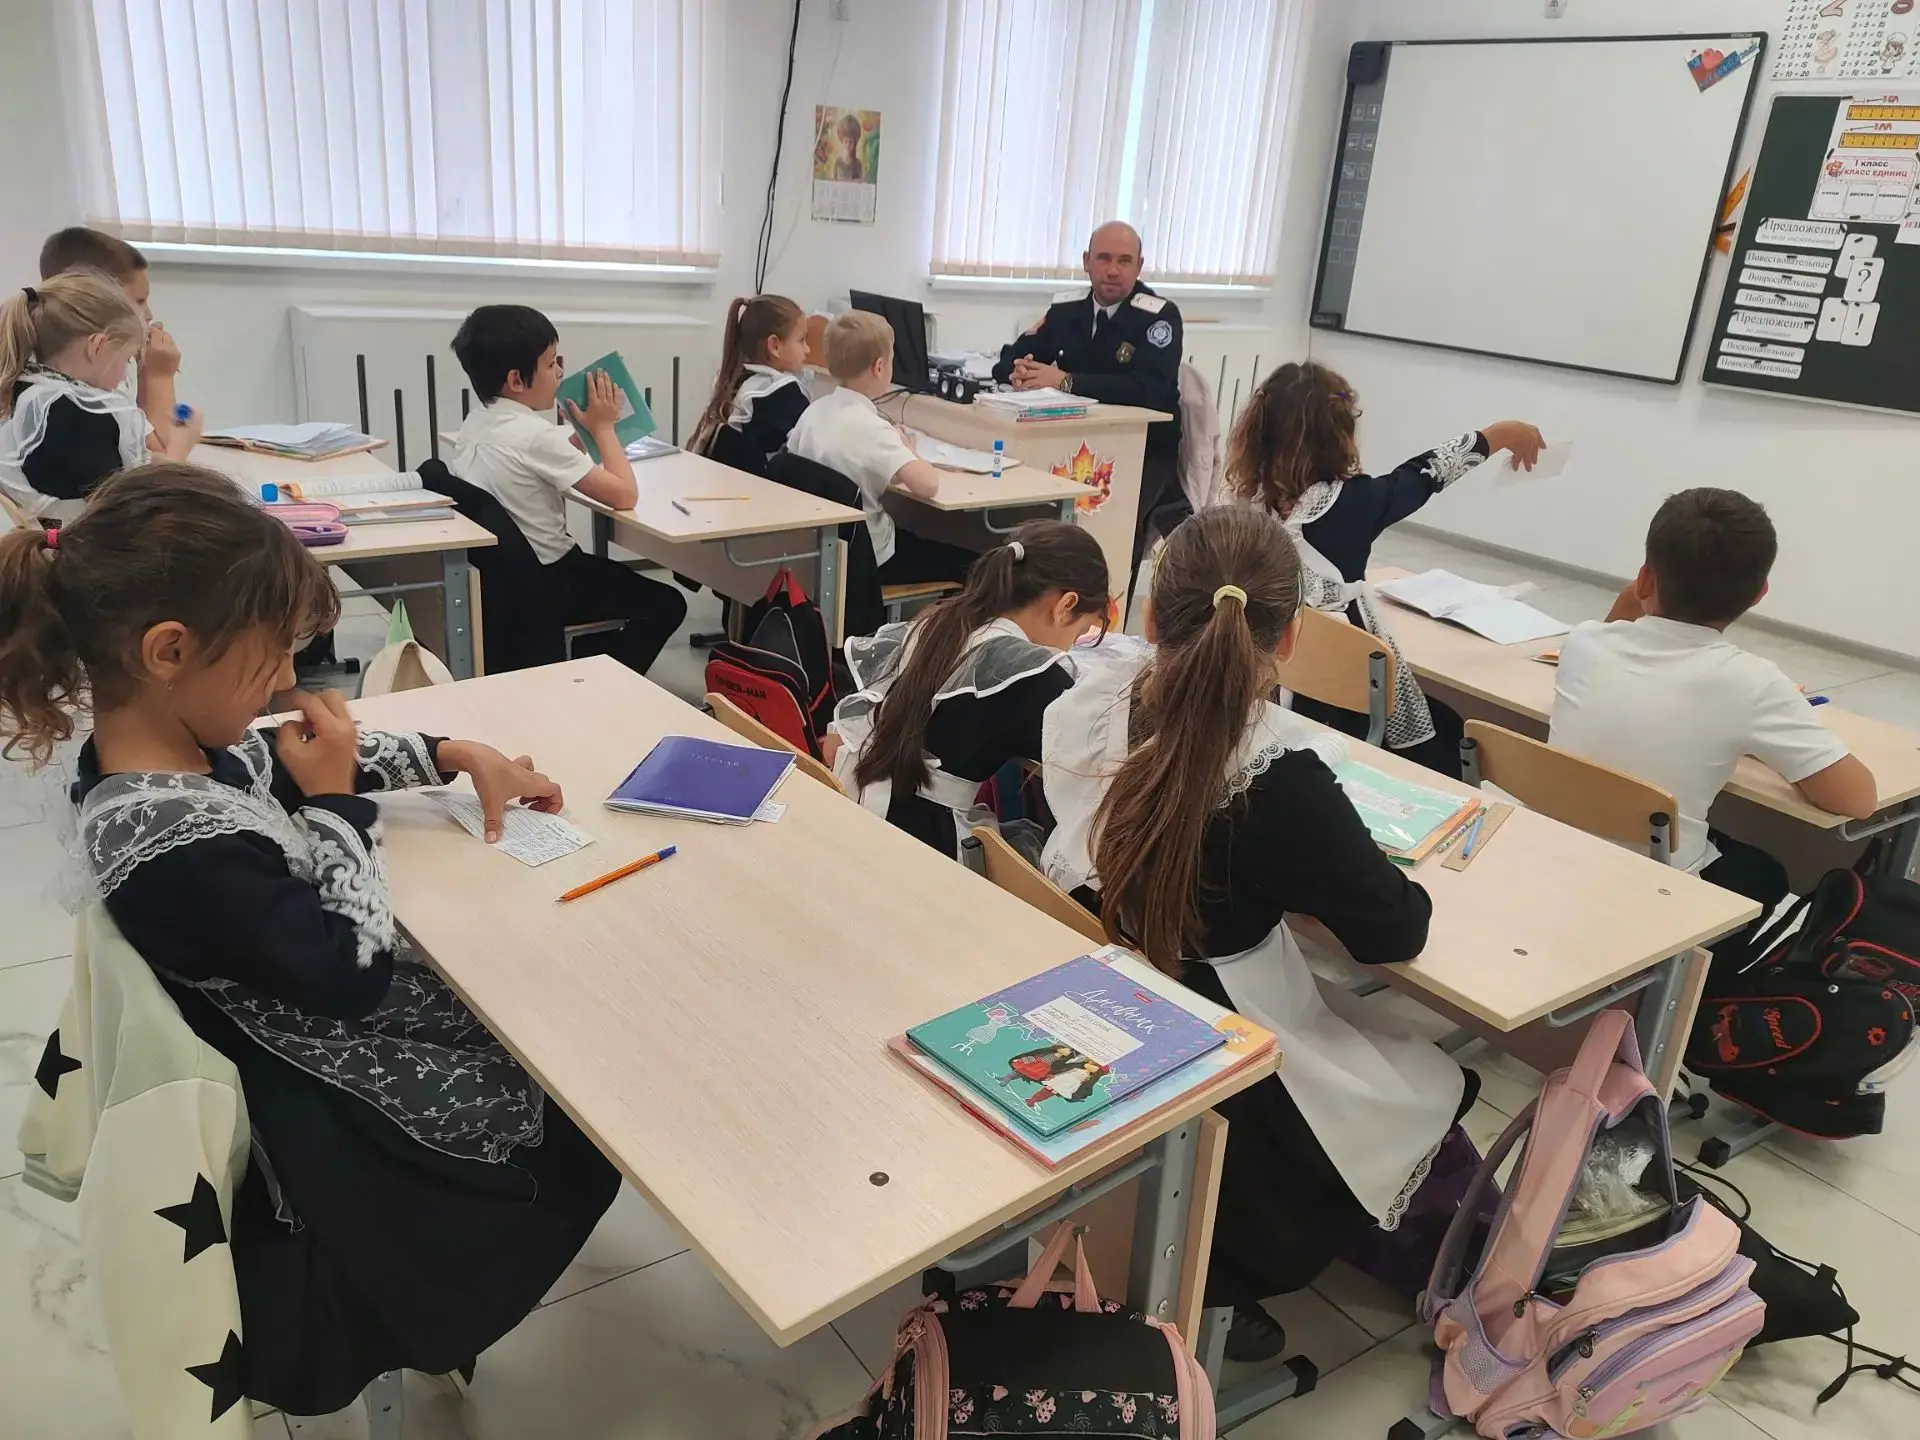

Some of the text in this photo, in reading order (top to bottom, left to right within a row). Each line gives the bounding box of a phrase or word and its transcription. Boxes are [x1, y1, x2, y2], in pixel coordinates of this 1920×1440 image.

[1764, 219, 1841, 235] Предложения
[1747, 251, 1830, 269] Повествовательные
[1748, 272, 1817, 289] Вопросительные
[1745, 293, 1810, 309] Побудительные
[1735, 312, 1809, 330] Предложения
